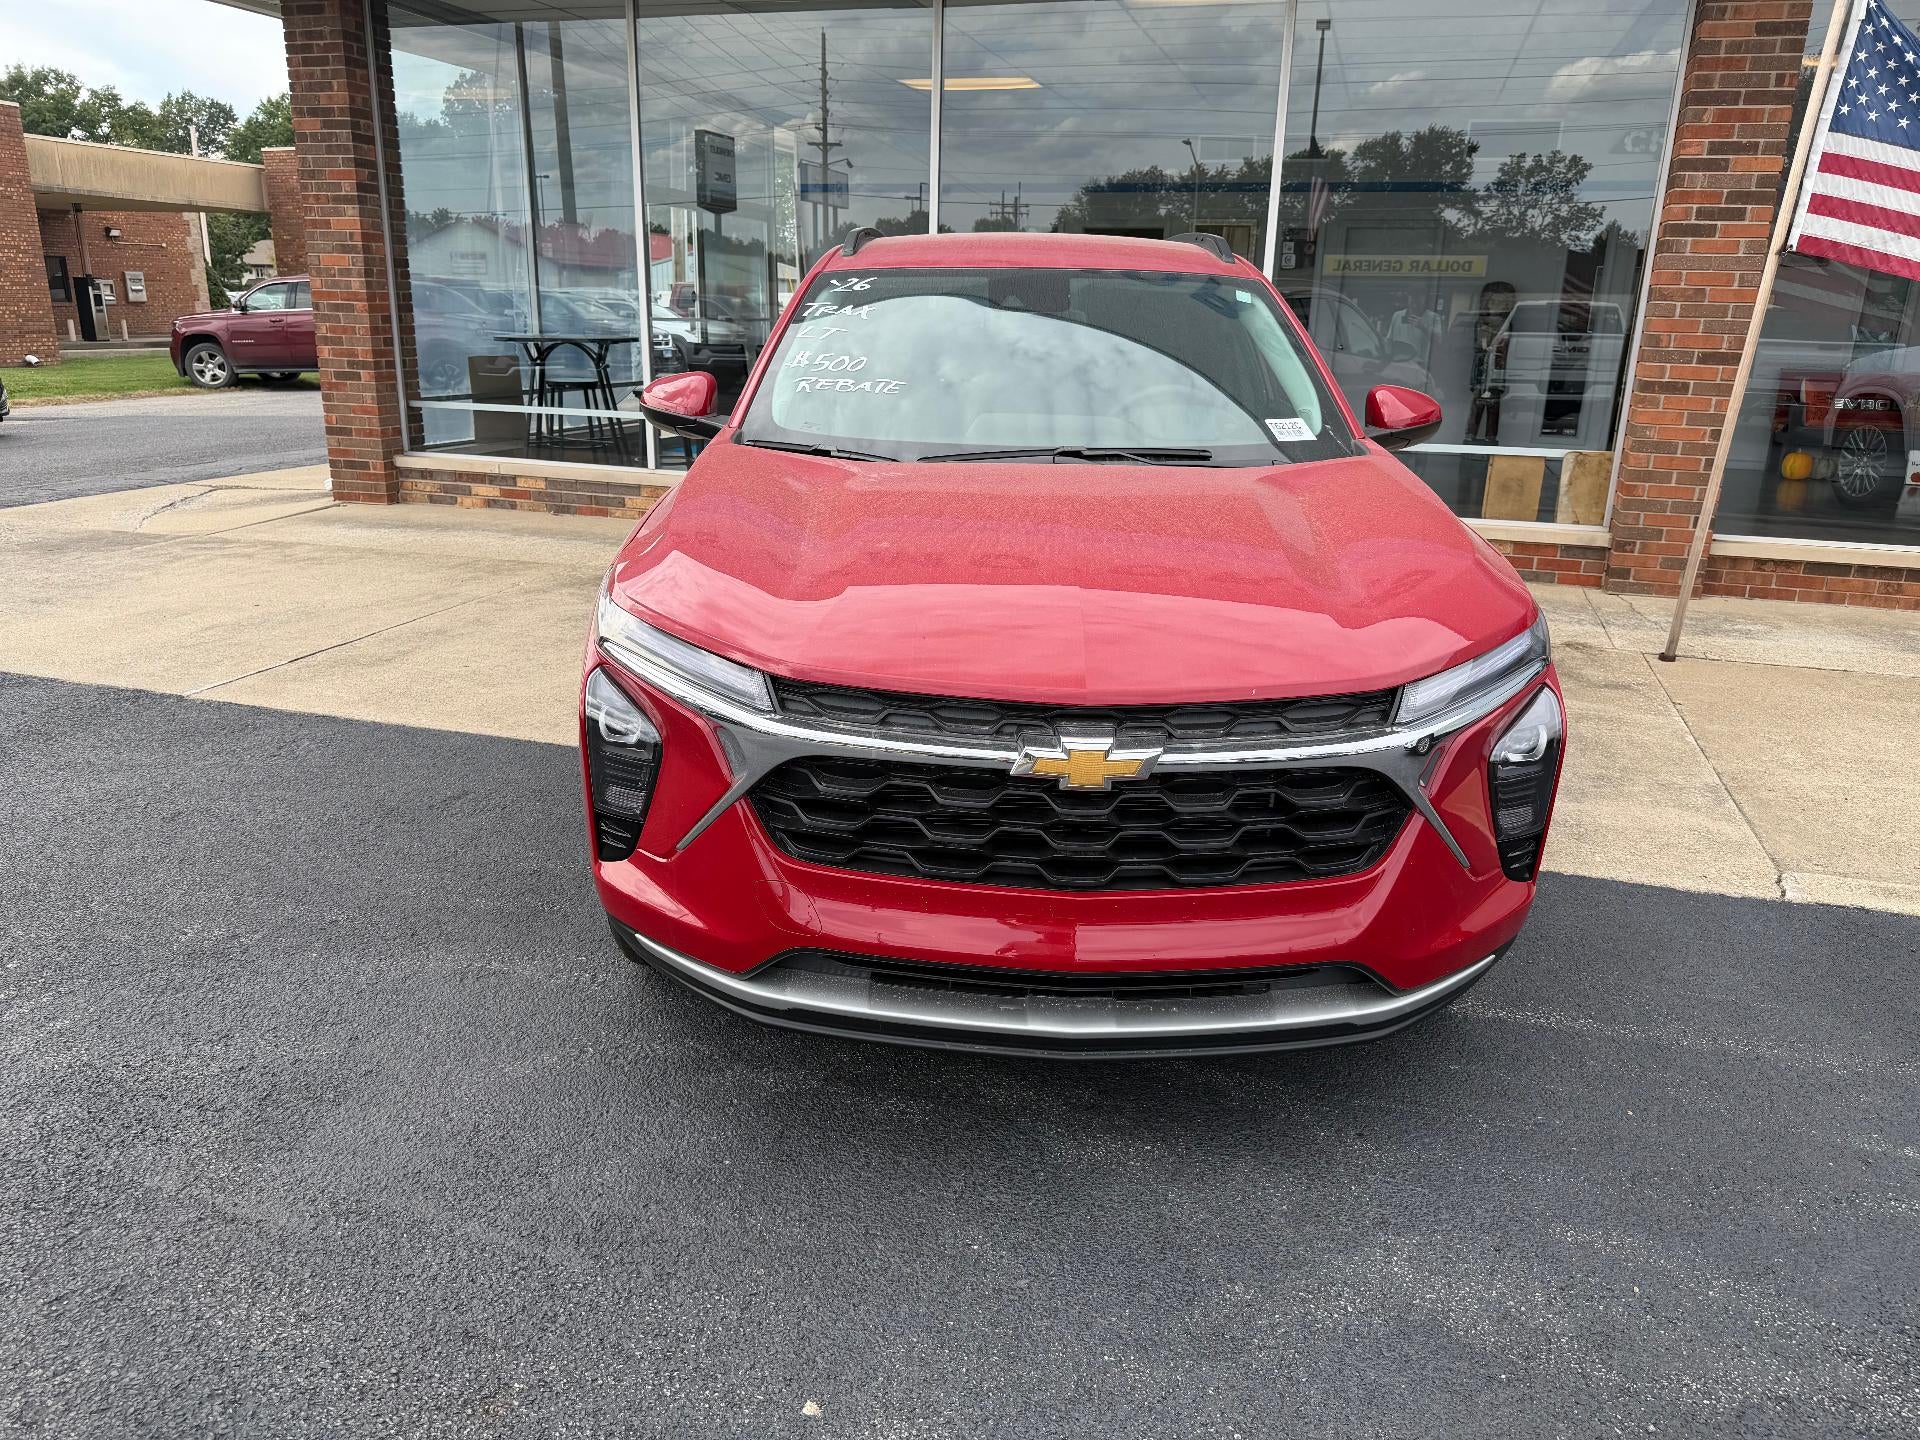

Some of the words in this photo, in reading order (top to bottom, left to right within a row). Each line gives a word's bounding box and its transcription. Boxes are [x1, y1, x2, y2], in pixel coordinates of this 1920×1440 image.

[802, 302, 876, 319] TRAX
[796, 326, 848, 340] LT
[784, 351, 868, 372] $500
[793, 377, 907, 394] REBATE
